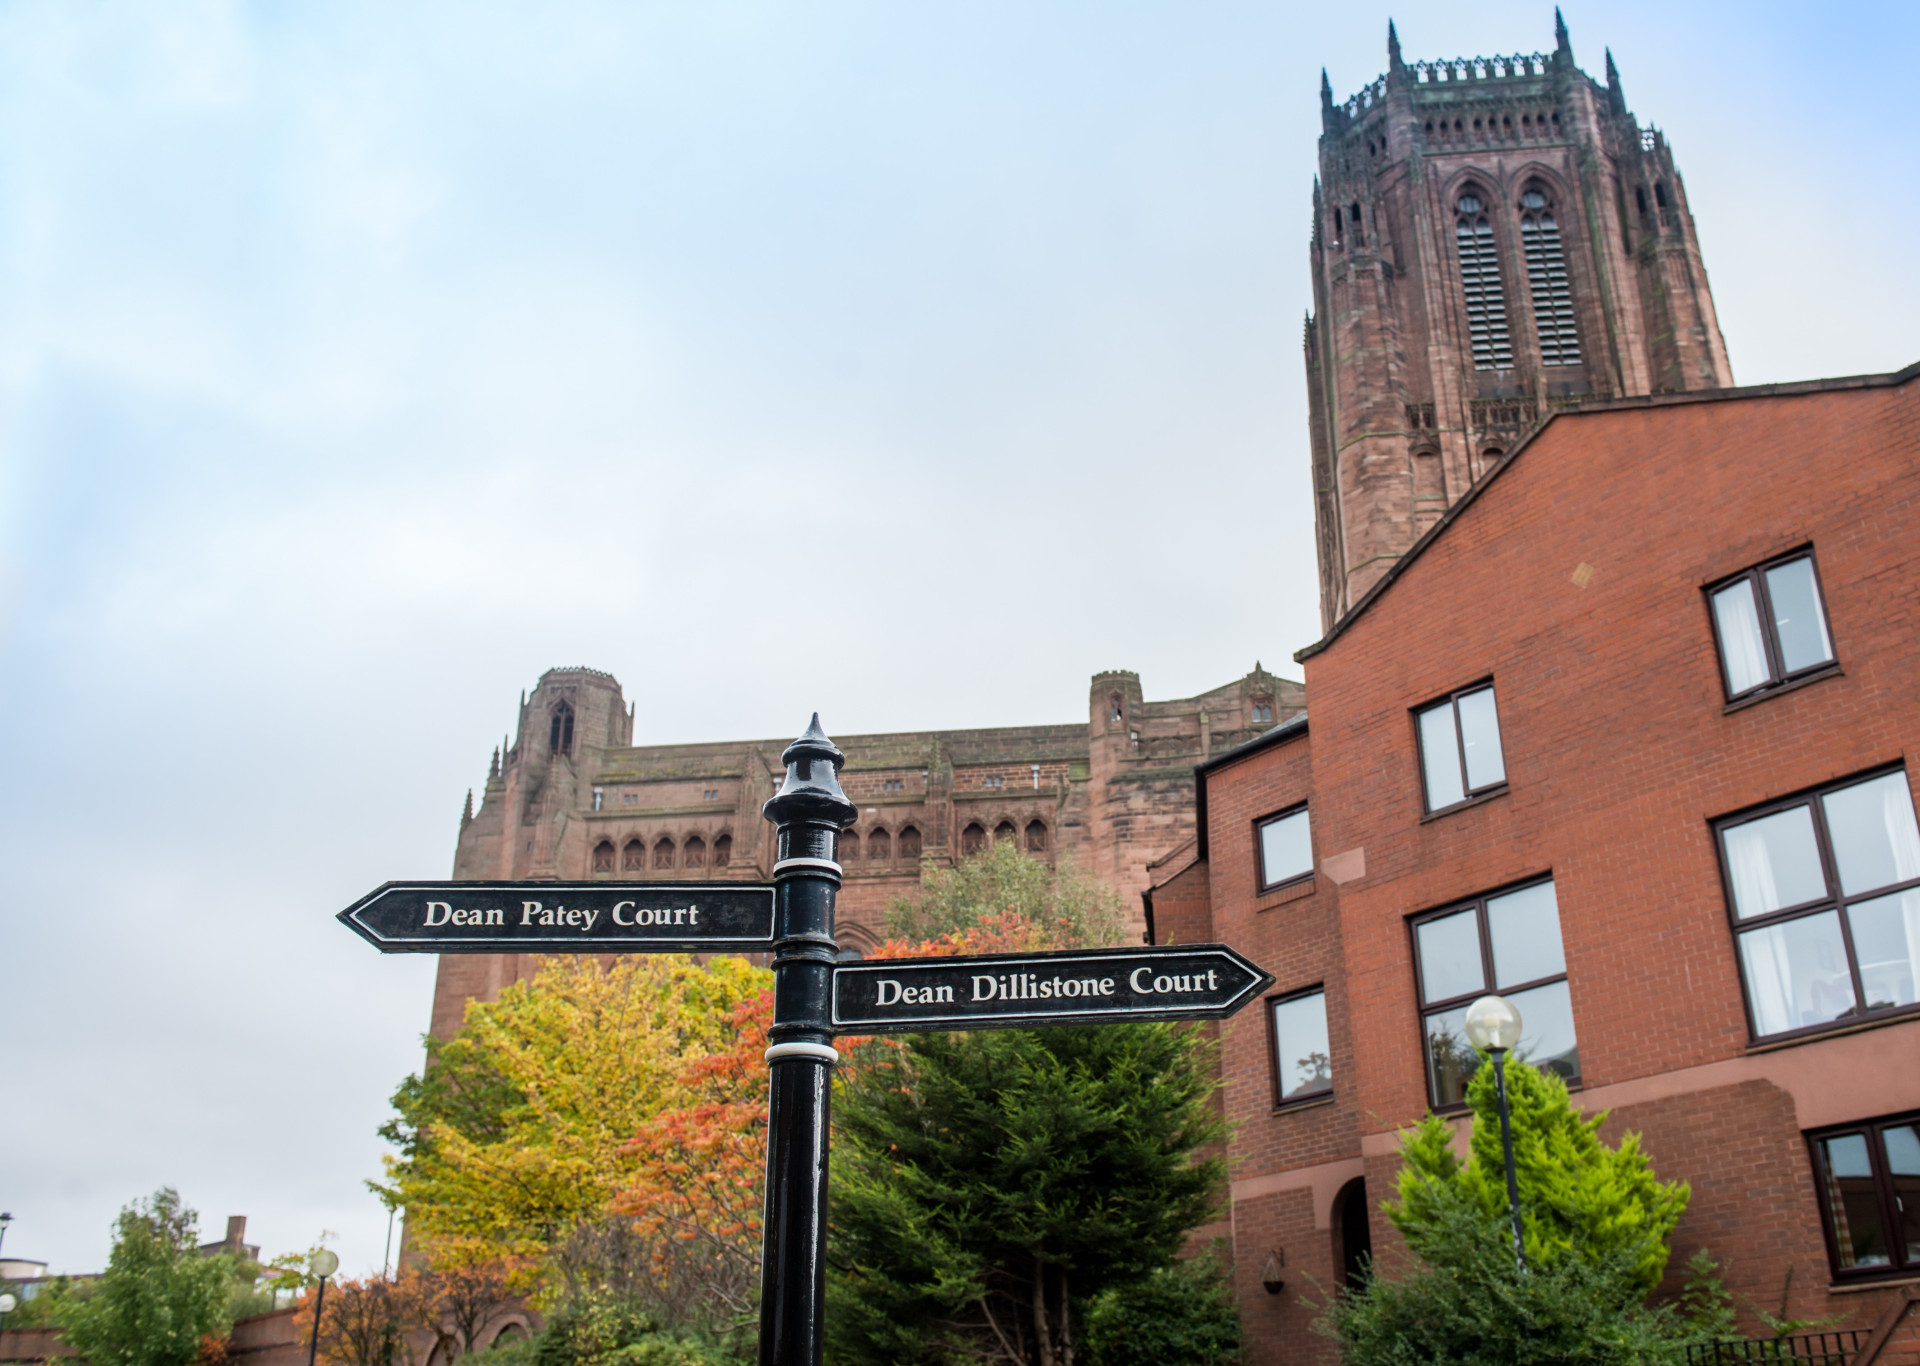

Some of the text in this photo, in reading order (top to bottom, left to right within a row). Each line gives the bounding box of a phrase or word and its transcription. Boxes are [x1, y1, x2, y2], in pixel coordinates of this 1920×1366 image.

[423, 900, 700, 931] Dean Patey Court
[875, 967, 1218, 1006] Dean Dillistone Court
